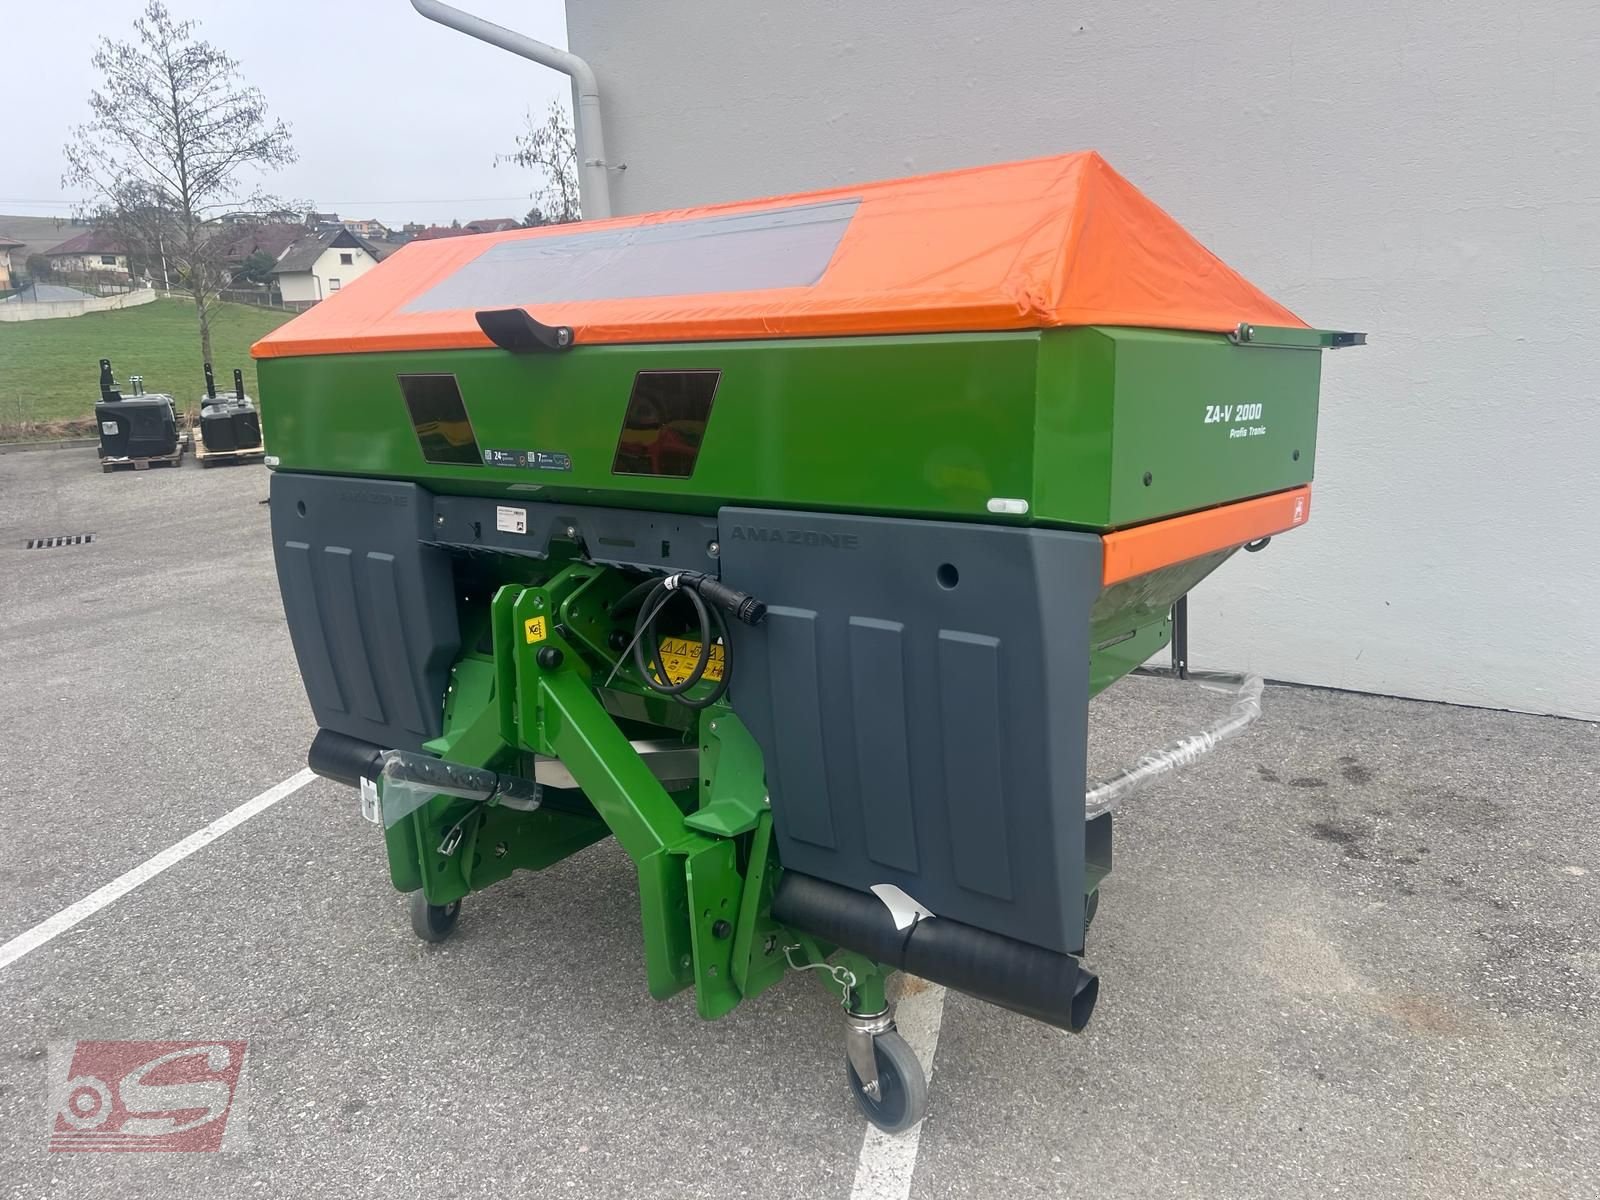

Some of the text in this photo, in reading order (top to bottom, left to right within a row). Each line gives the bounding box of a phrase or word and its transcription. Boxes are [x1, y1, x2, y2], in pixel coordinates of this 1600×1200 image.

[1204, 403, 1262, 423] ZA-V 2000
[1230, 425, 1266, 438] Profis Tronic
[493, 451, 502, 460] 24
[730, 525, 859, 550] AMAZONE
